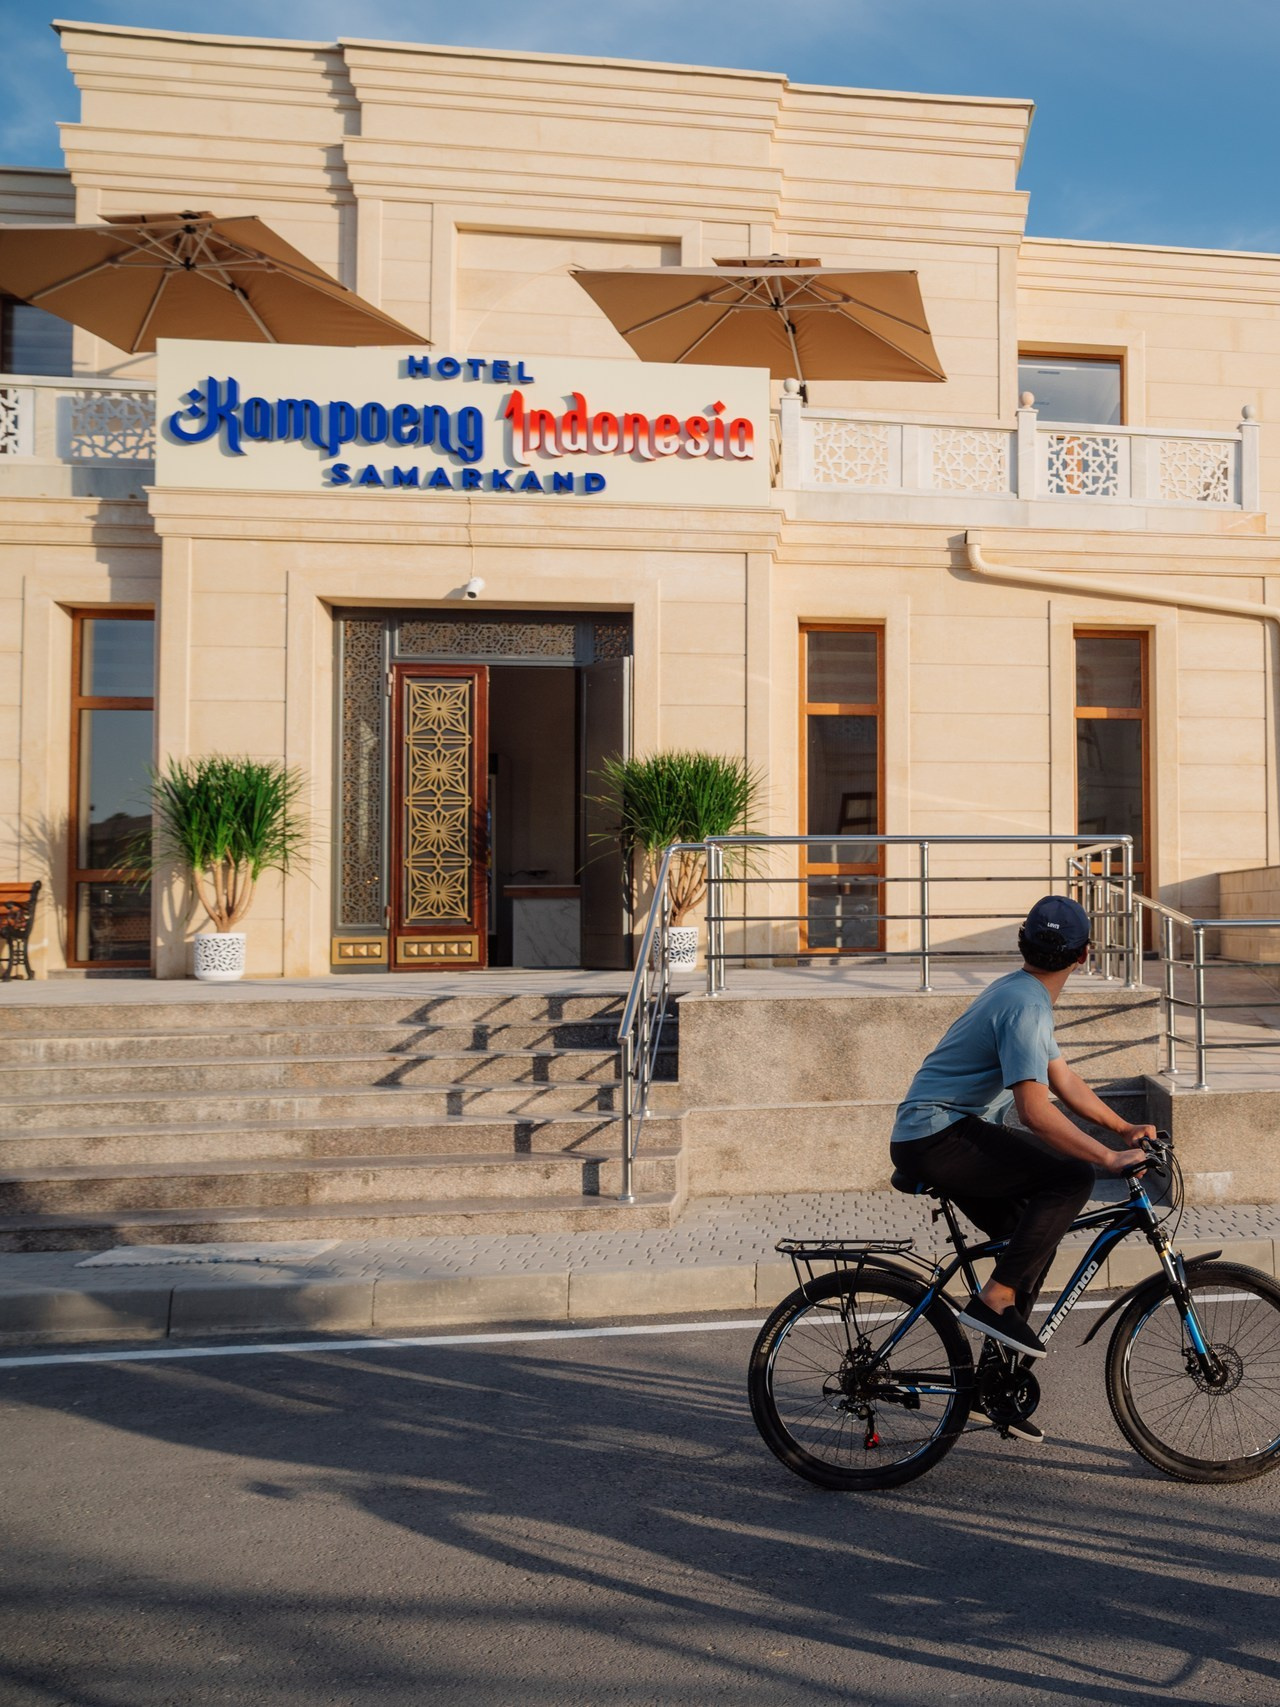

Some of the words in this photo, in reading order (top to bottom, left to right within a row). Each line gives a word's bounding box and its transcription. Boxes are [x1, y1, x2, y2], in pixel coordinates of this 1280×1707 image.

[406, 355, 535, 383] HOTEL
[168, 376, 485, 464] Kampoeng
[504, 389, 755, 466] Indonesia
[330, 463, 607, 495] SAMARKAND
[760, 1304, 797, 1354] Shimanoo
